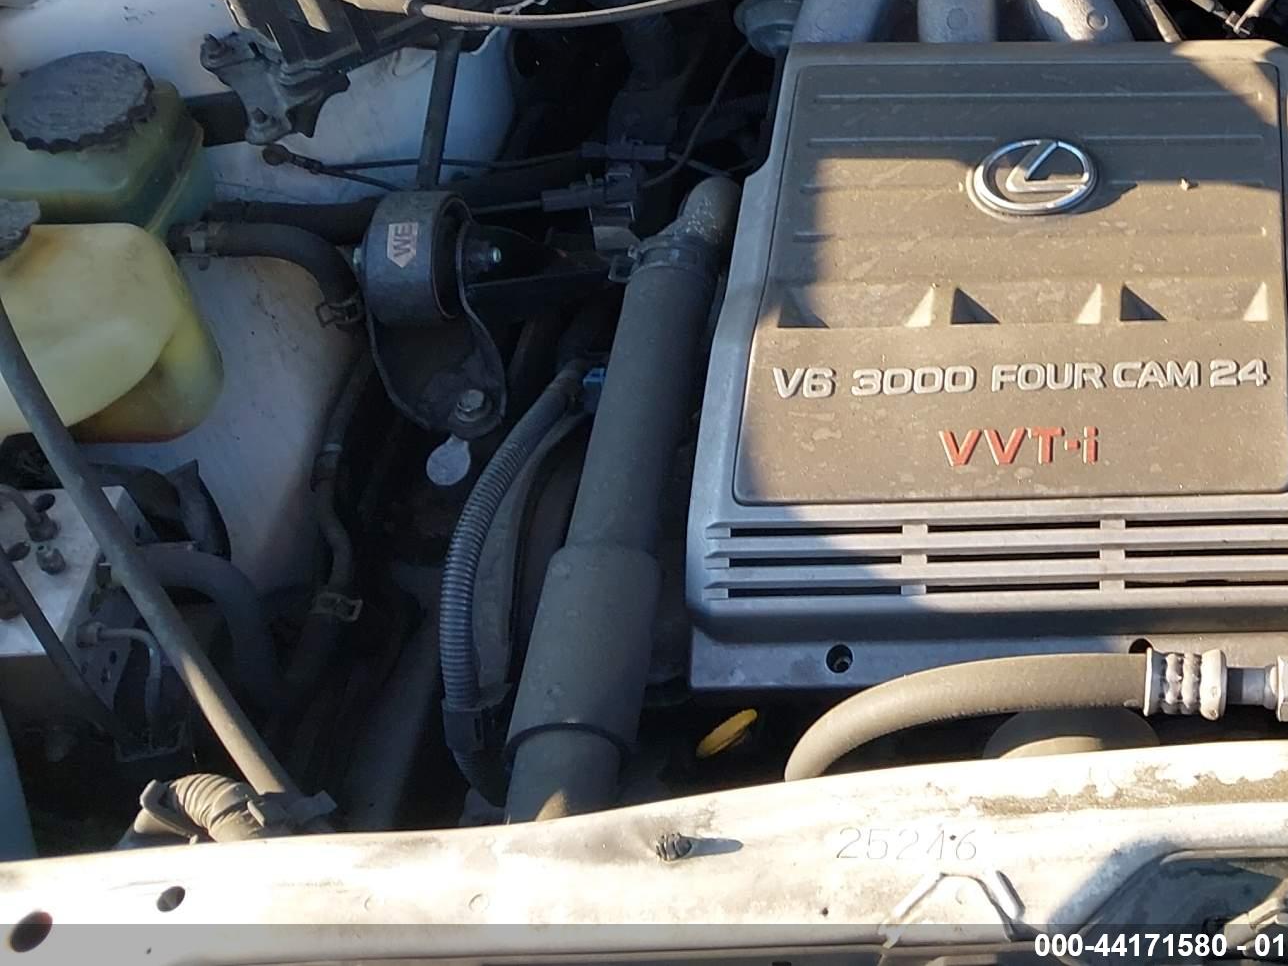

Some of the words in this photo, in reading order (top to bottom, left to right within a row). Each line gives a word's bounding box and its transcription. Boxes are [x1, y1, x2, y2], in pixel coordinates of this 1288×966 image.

[774, 367, 836, 398] V6
[851, 365, 976, 396] 3000
[990, 362, 1107, 392] FOUR
[1112, 360, 1200, 389] CAM
[1208, 359, 1269, 387] 24
